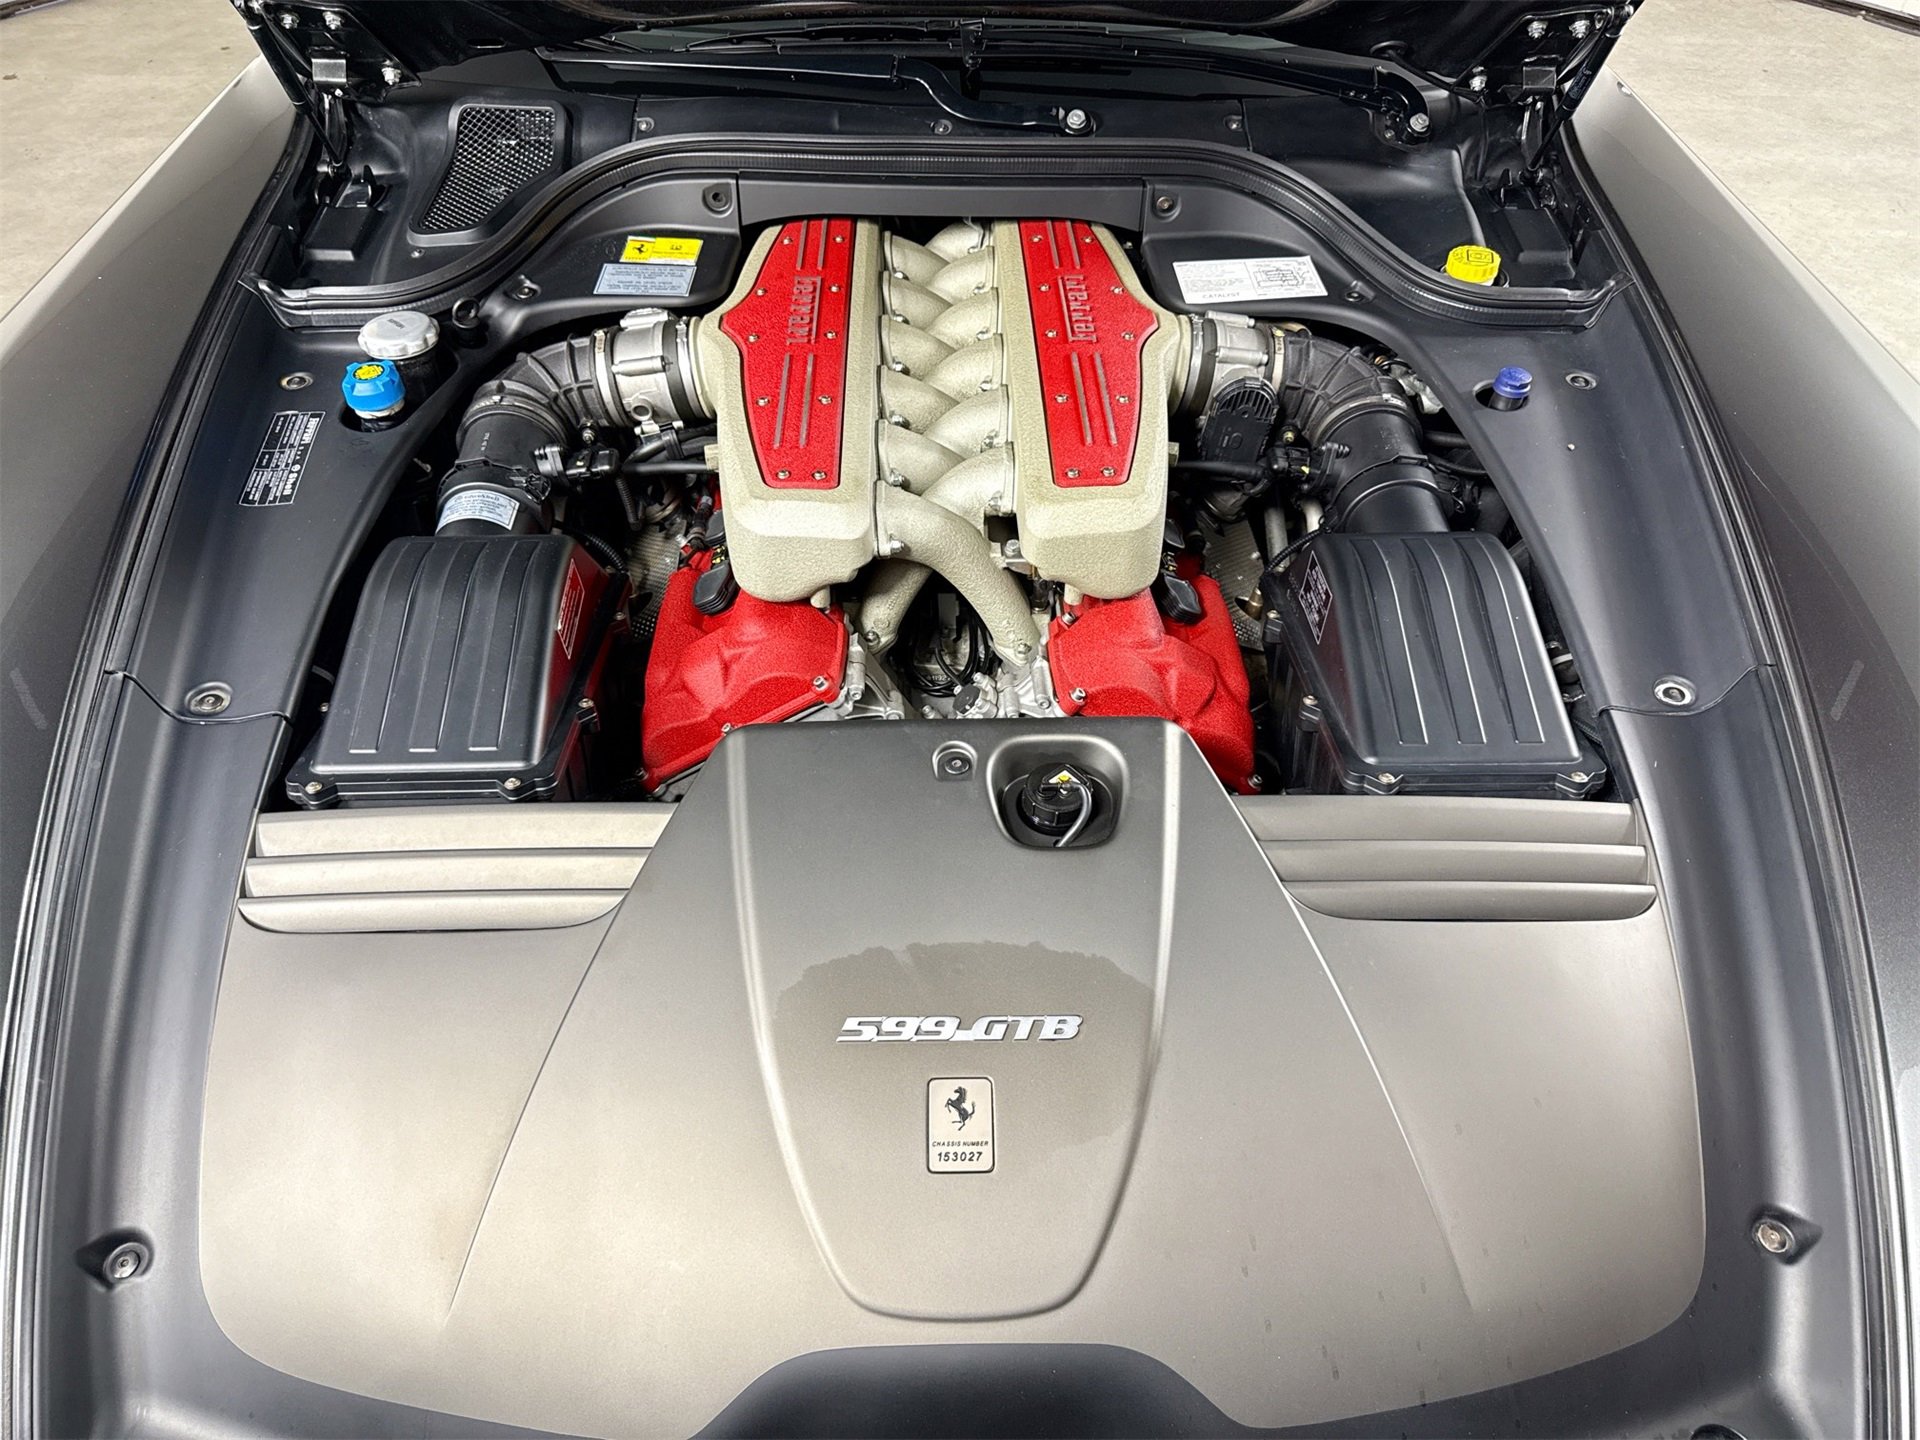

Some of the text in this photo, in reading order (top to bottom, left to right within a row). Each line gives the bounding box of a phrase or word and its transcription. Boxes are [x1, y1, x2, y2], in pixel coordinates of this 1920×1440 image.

[1202, 291, 1240, 299] CATALYST
[1057, 274, 1097, 342] Ferrari
[282, 472, 298, 496] Shell
[836, 1015, 1084, 1042] 599 GTB
[937, 1151, 983, 1162] 153027
